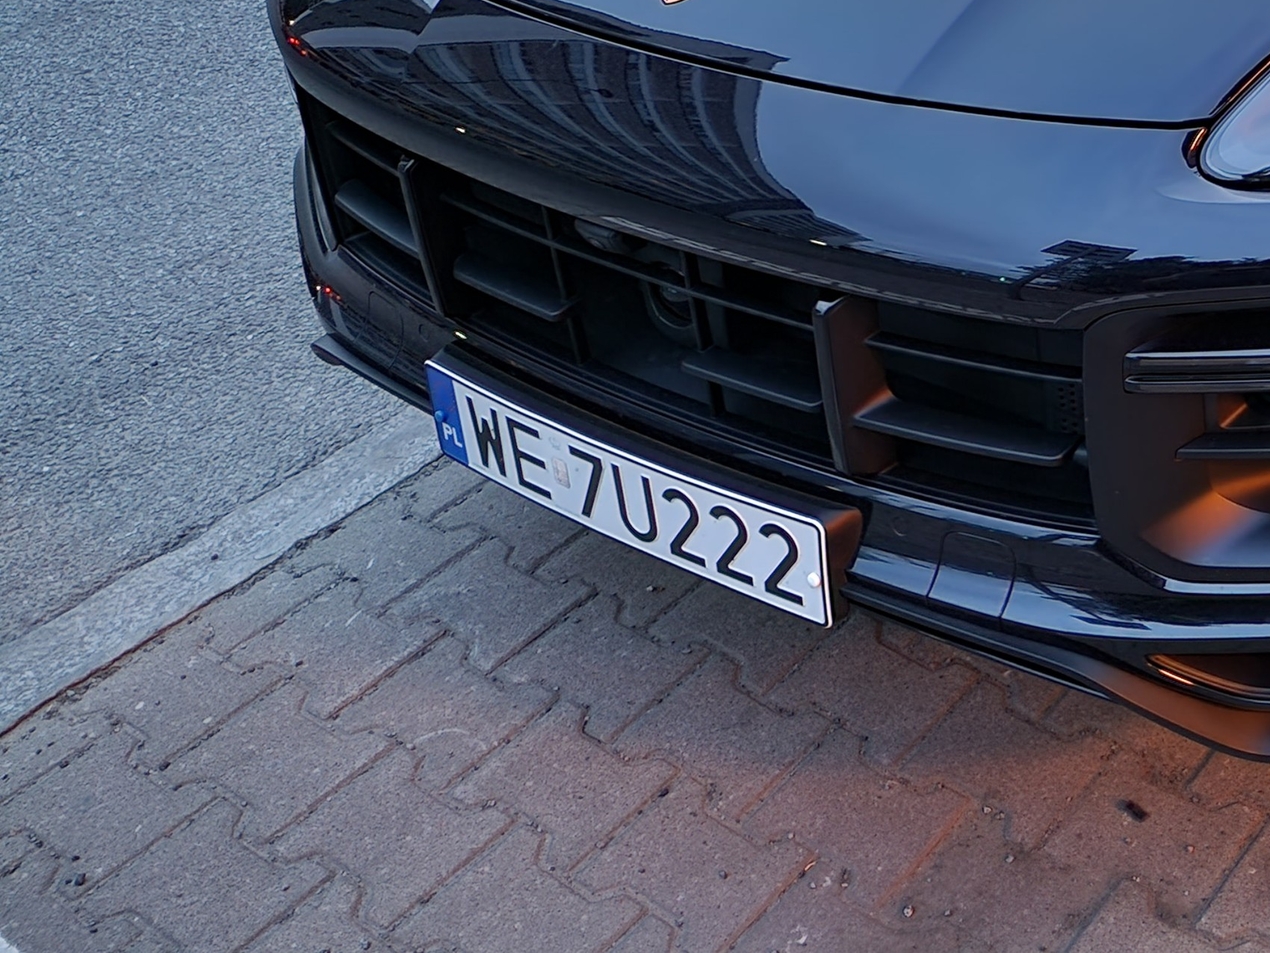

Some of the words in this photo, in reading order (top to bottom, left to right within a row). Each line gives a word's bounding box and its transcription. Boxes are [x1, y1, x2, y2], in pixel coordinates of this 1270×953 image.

[442, 422, 463, 449] PL
[465, 395, 552, 500] WE
[568, 445, 803, 606] 7U222
